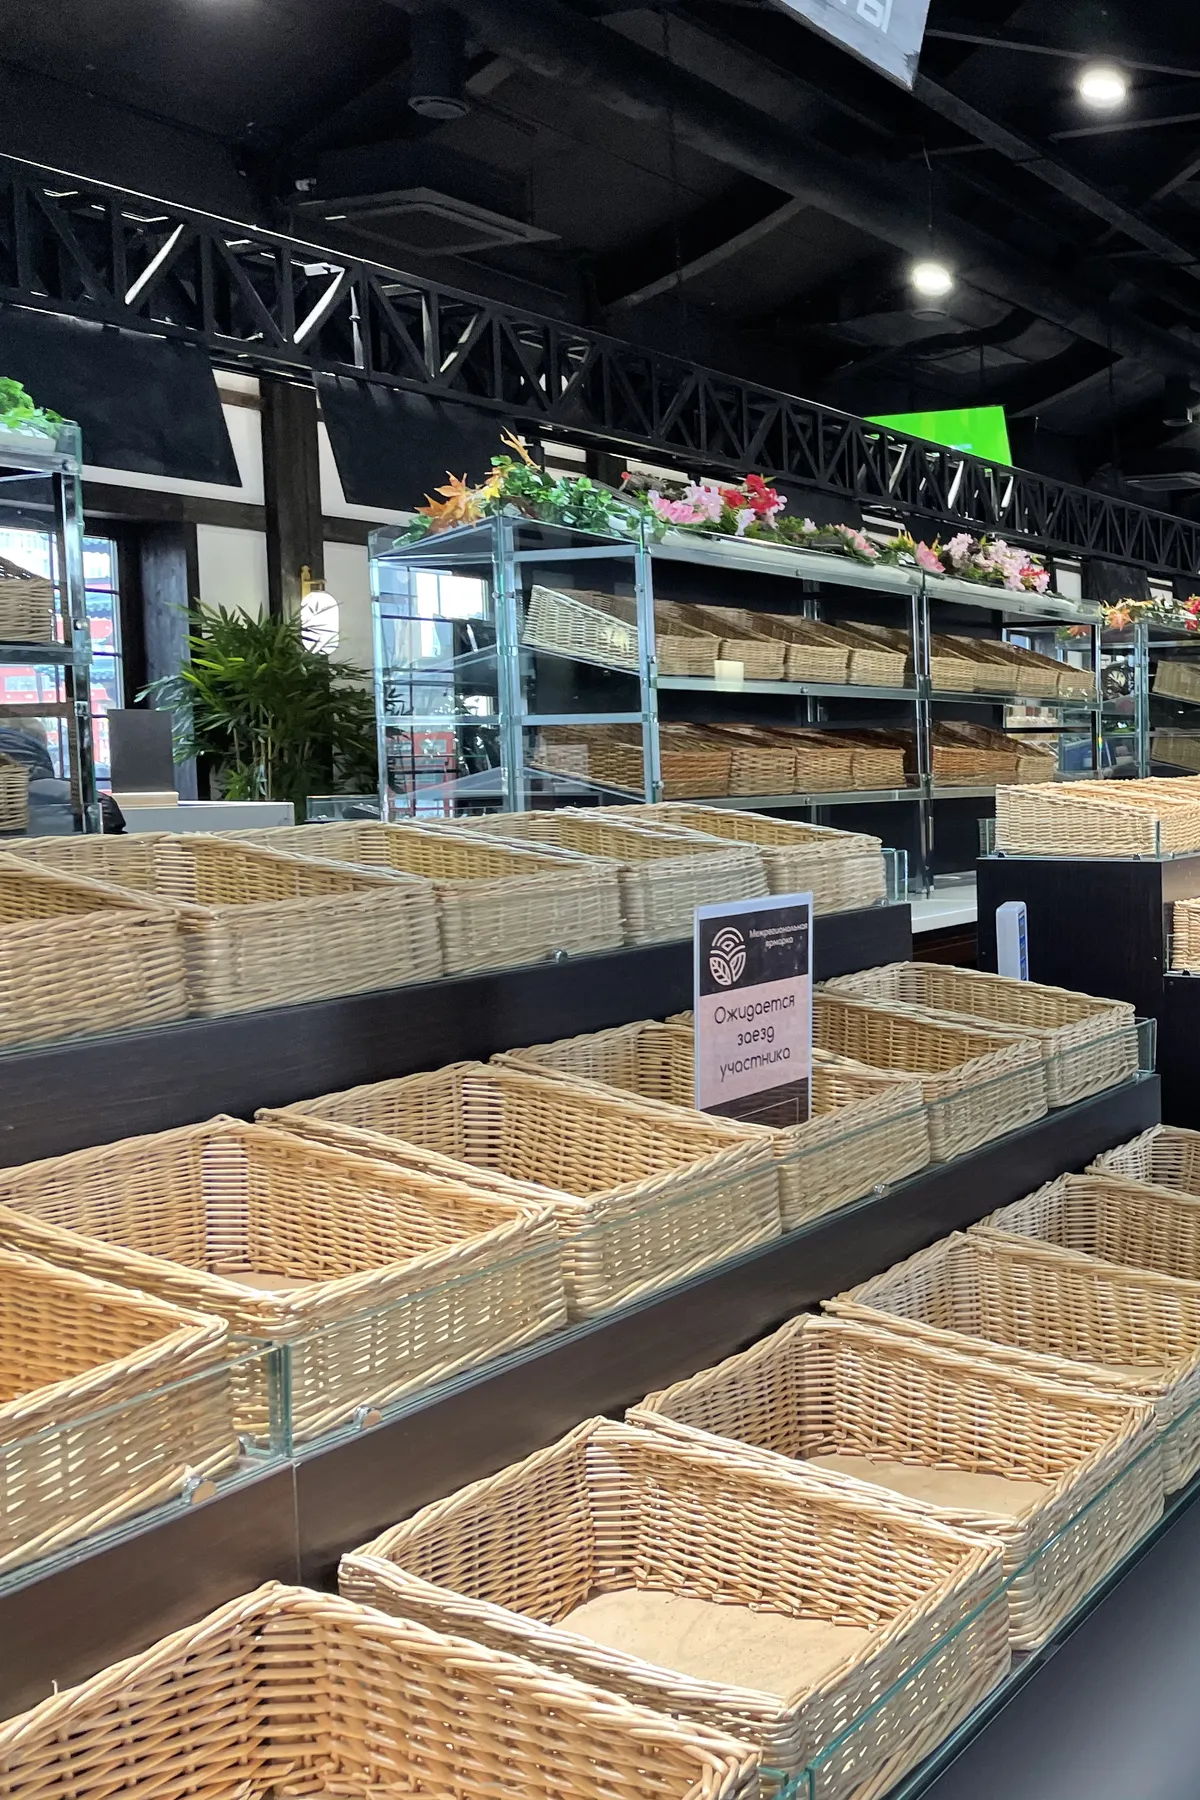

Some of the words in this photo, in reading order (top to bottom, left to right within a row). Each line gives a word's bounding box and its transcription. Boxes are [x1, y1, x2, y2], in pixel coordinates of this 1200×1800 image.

[714, 994, 795, 1024] Ожидается
[737, 1025, 775, 1046] заезд
[719, 1046, 791, 1082] участника
